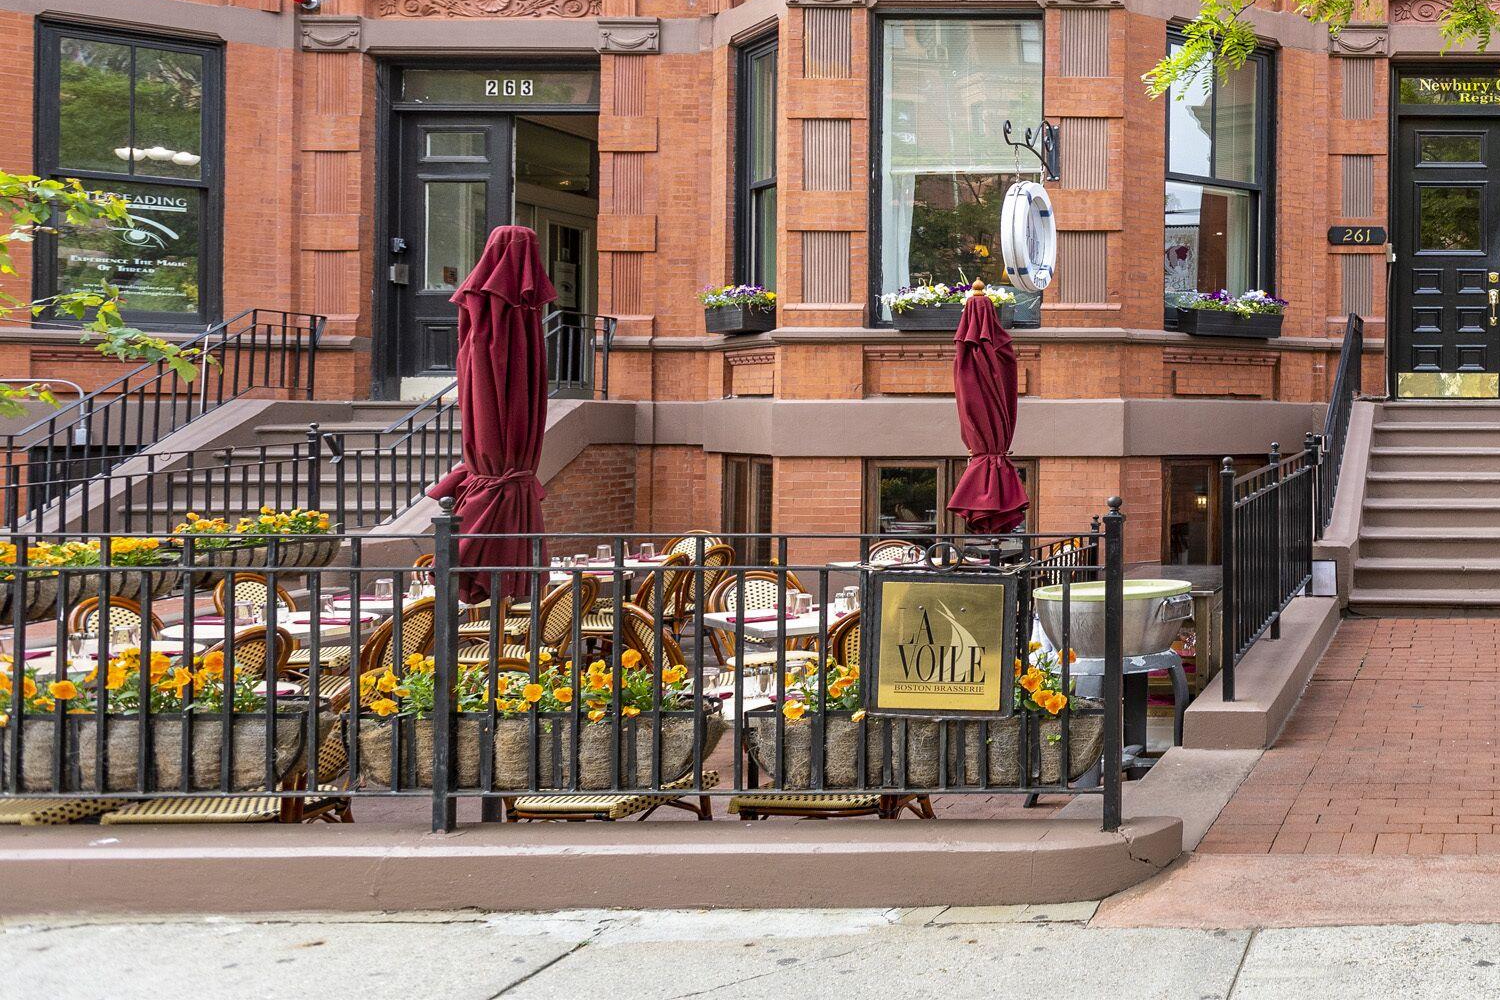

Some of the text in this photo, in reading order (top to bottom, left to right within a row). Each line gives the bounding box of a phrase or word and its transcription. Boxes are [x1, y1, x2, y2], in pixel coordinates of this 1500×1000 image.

[487, 80, 532, 95] 263
[1419, 78, 1490, 94] Newbury
[1342, 229, 1371, 243] 261
[897, 607, 935, 645] LA
[895, 644, 986, 683] VOILE
[894, 684, 985, 693] BOSTON BRASSERIE
